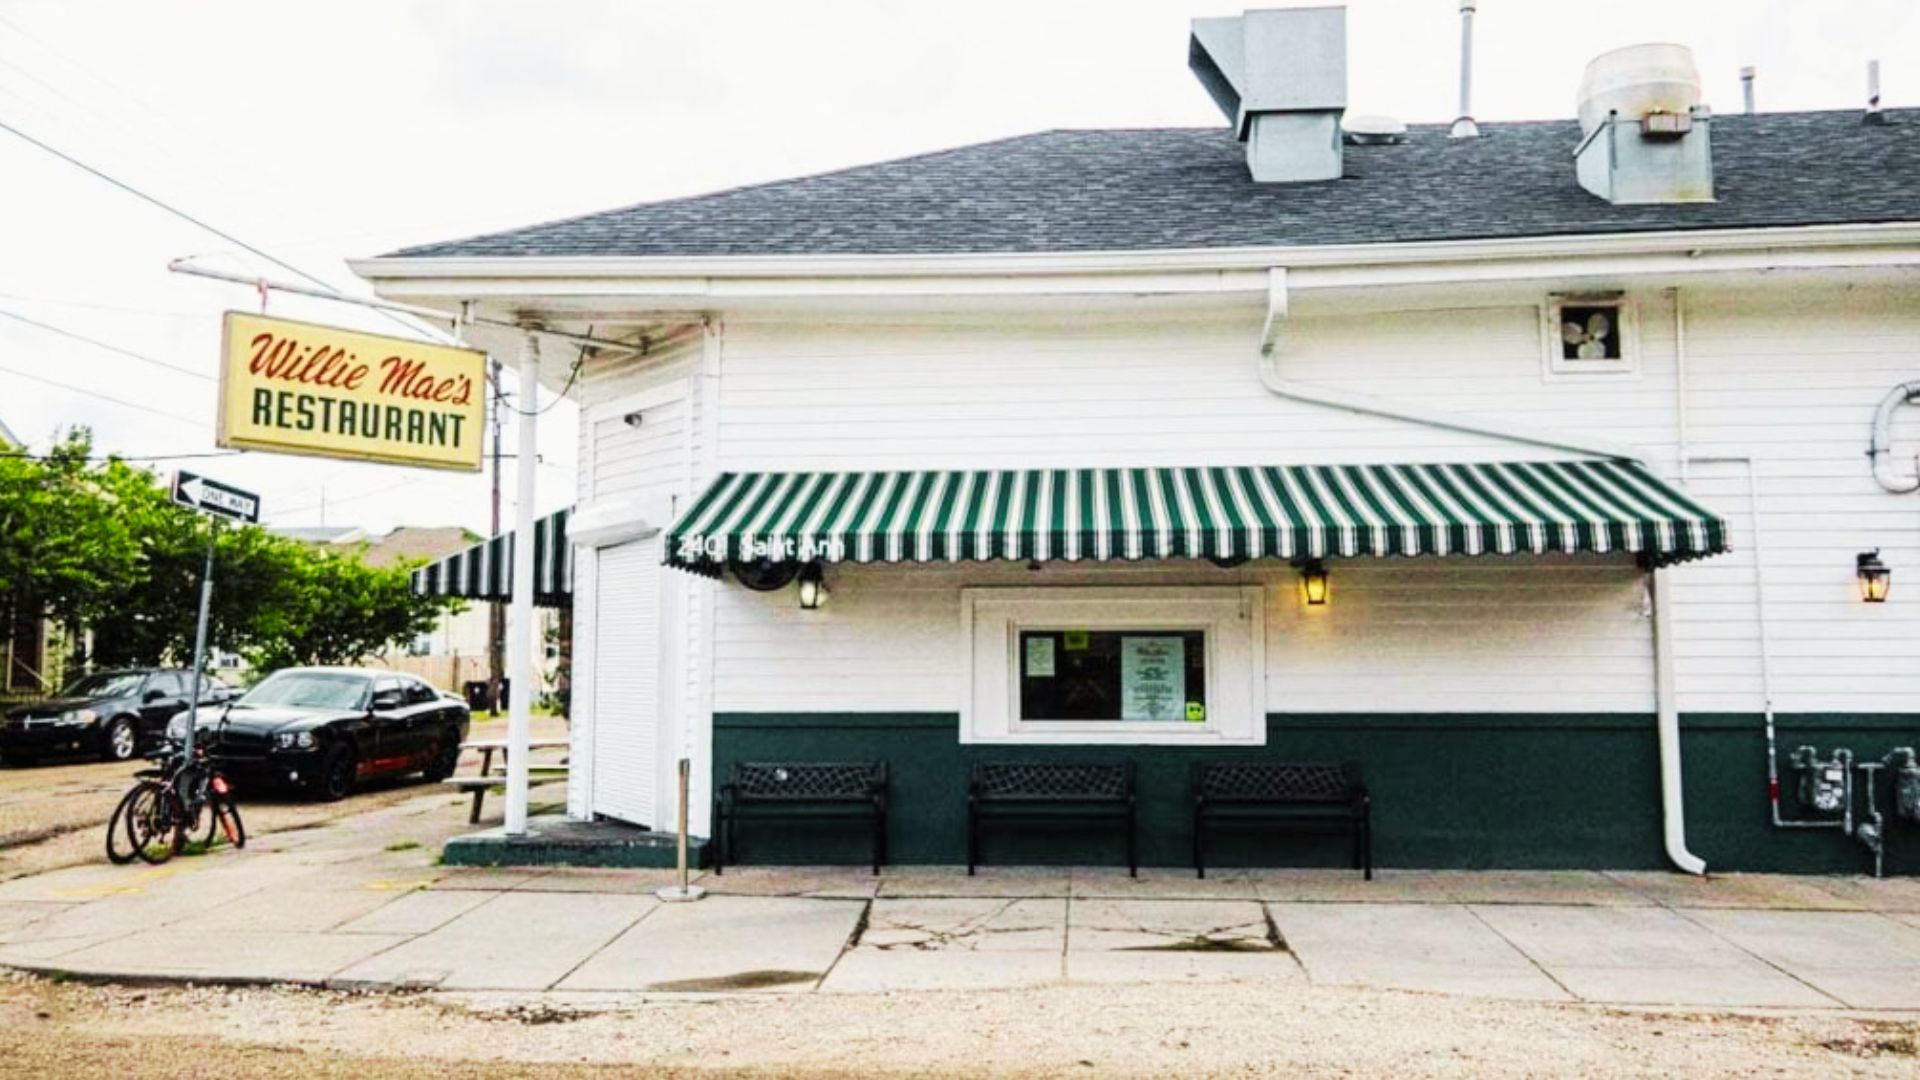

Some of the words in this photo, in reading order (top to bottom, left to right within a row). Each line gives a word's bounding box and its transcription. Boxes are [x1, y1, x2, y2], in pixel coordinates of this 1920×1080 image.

[250, 333, 368, 389] Willie
[380, 356, 471, 406] Mae's
[253, 388, 466, 448] RESTAURANT
